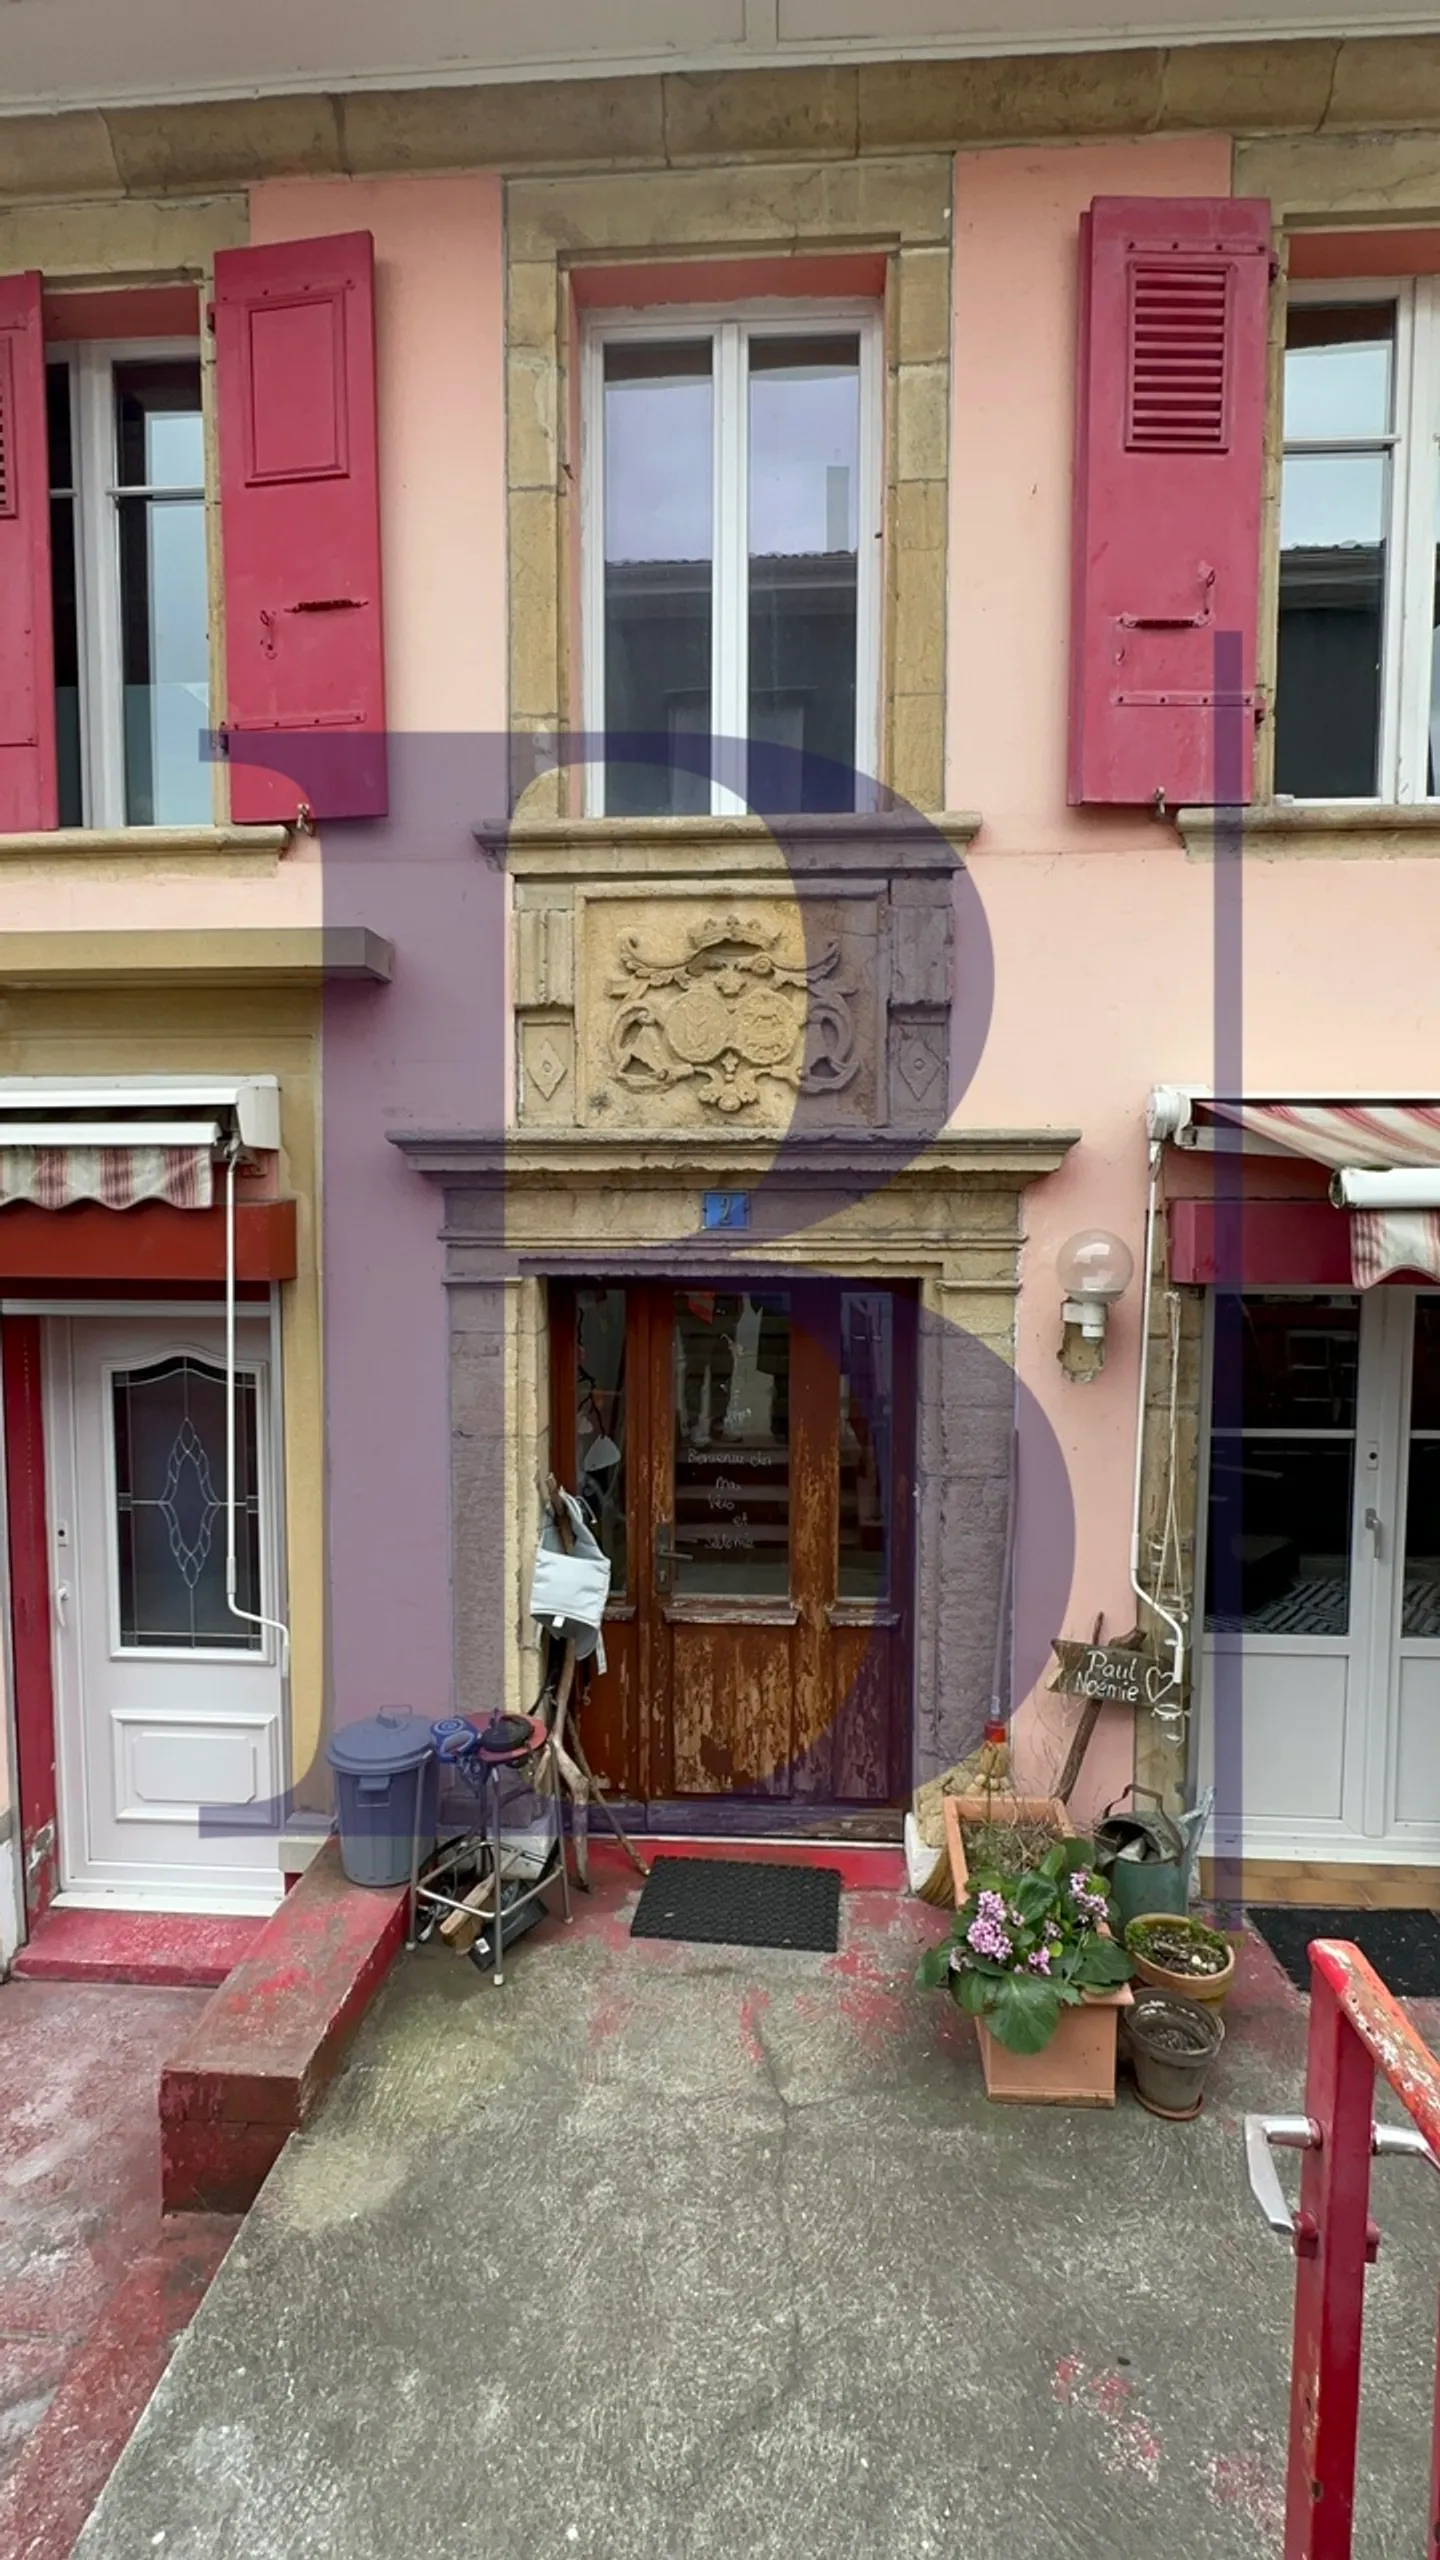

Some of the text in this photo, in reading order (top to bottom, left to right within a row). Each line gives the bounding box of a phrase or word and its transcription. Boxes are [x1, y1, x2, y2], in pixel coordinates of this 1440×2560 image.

[732, 1512, 748, 1528] et
[1086, 1650, 1138, 1682] Paul
[1073, 1671, 1140, 1702] Noémie
